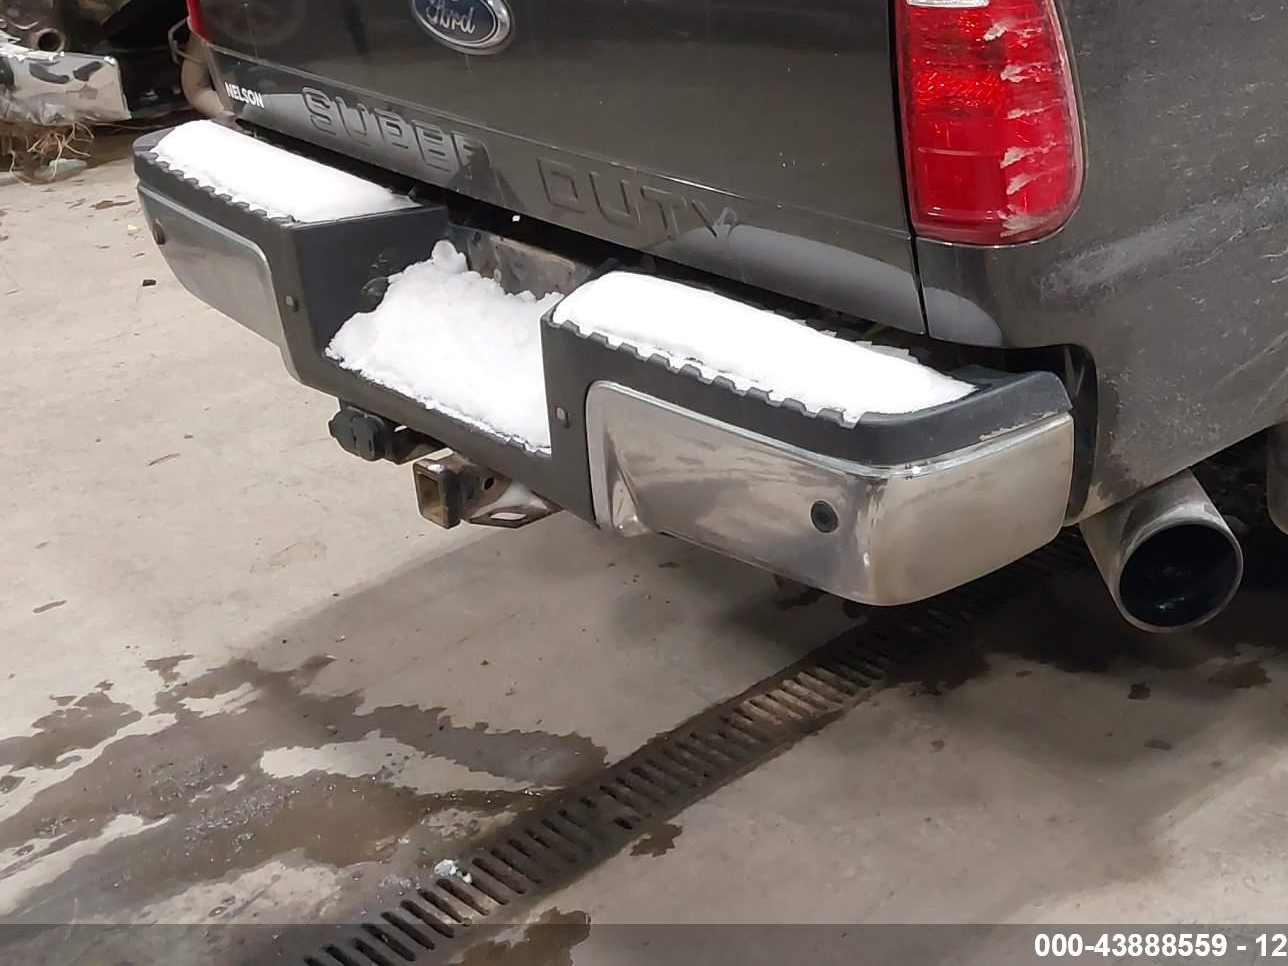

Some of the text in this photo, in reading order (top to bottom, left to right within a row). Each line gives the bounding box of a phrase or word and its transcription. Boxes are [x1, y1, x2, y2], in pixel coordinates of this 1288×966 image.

[224, 81, 265, 109] NELSON
[301, 86, 738, 246] SUPER DUTY
